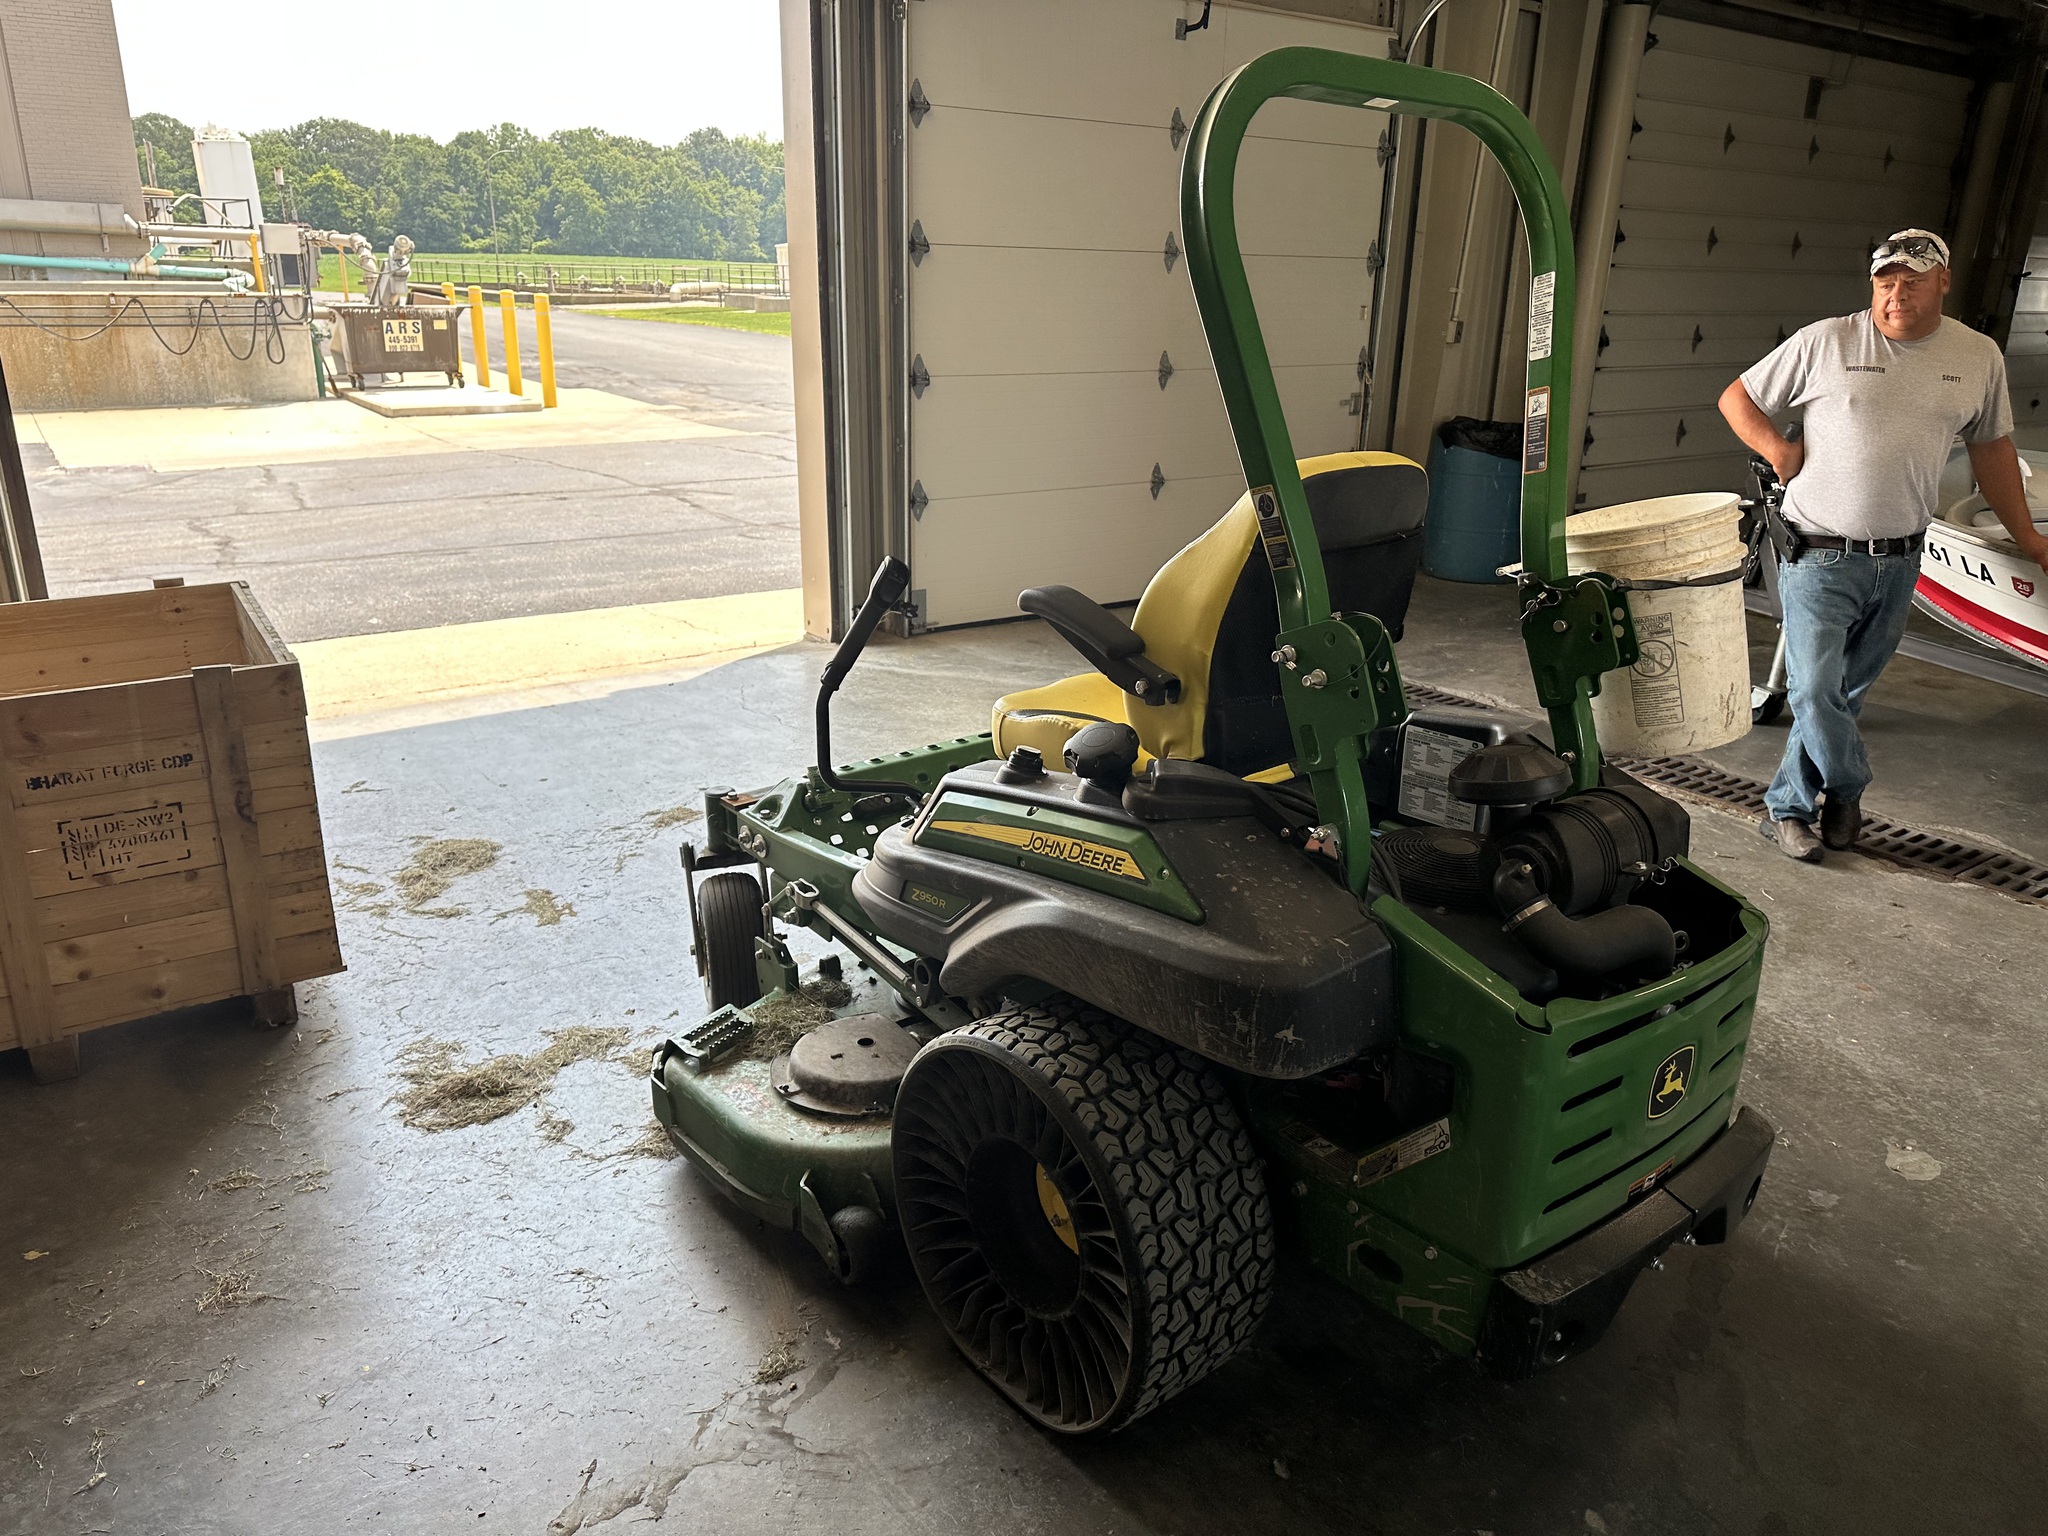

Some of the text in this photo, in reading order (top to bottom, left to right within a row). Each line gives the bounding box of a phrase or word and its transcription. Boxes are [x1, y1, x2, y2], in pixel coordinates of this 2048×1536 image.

[1845, 365, 1886, 374] WASTEWATER
[1941, 374, 1961, 383] SCOTT
[1922, 539, 1996, 585] 61 LA
[1633, 614, 1670, 625] WARNING
[1640, 622, 1664, 632] AVISO
[102, 759, 157, 779] FORGE
[161, 753, 193, 770] CDP
[110, 851, 133, 865] HT
[1022, 832, 1126, 873] JOHN DEERE
[911, 887, 946, 909] Z950R
